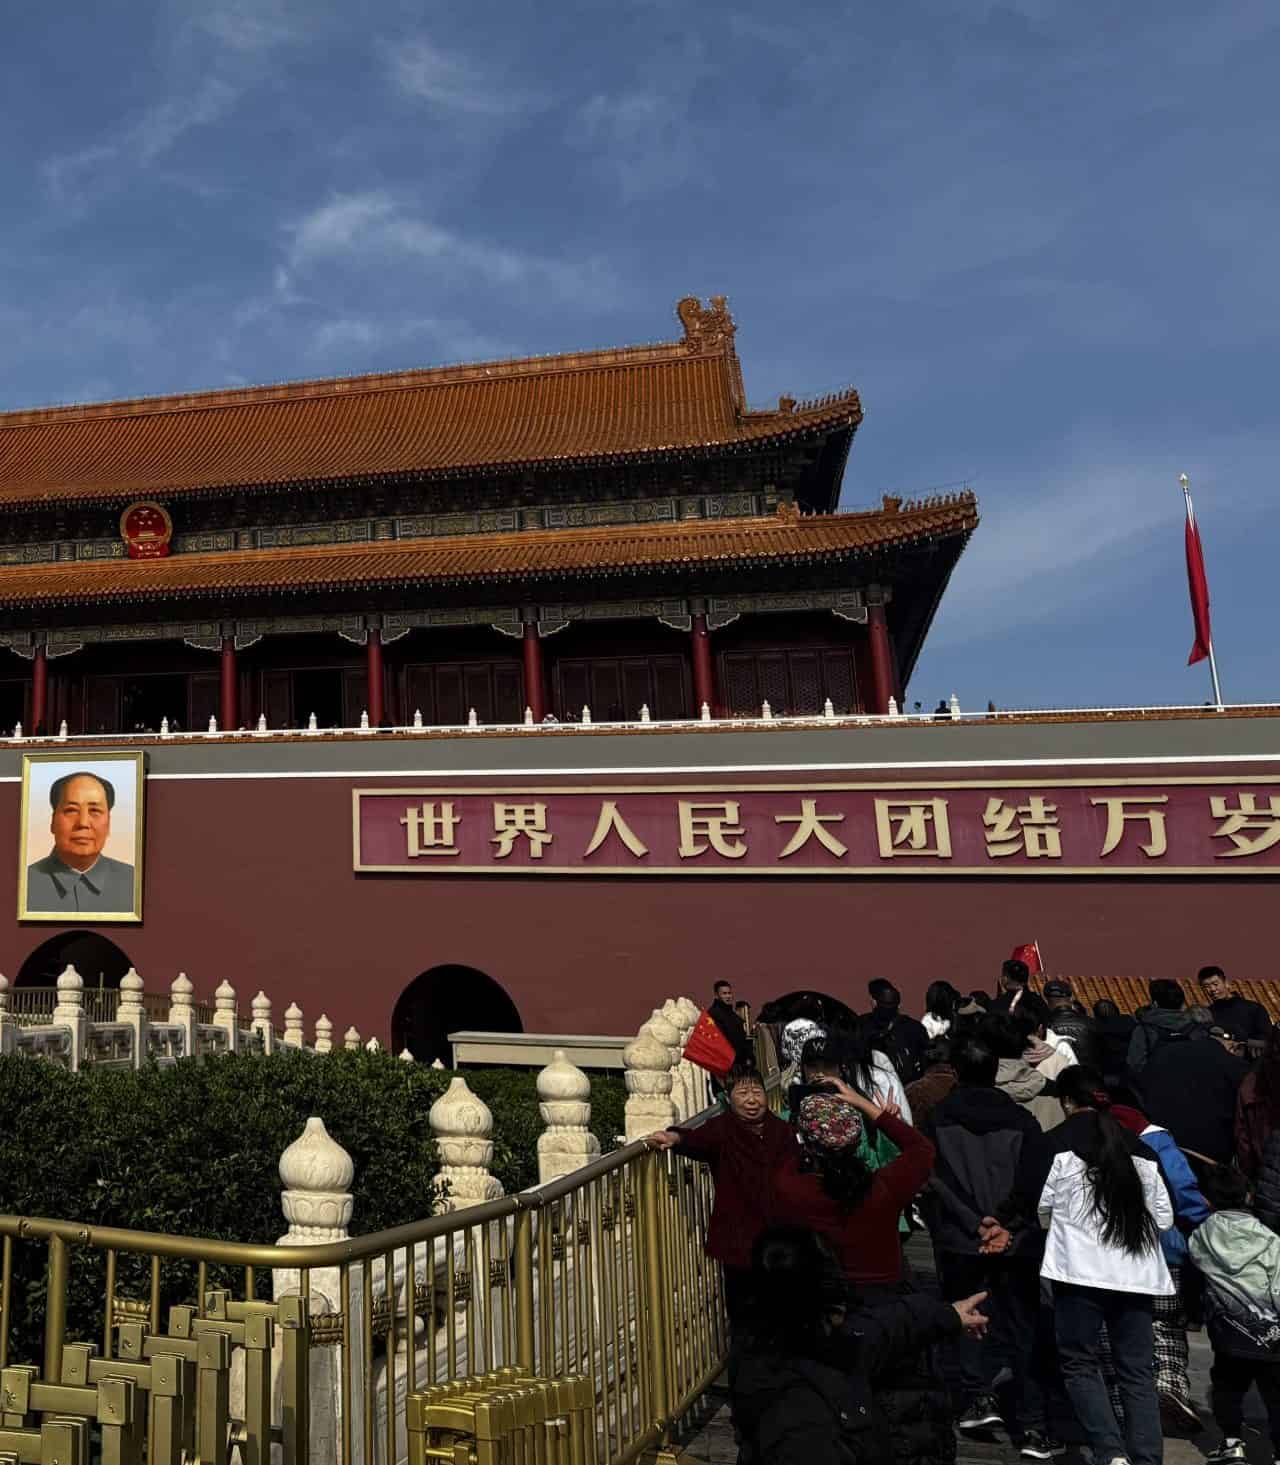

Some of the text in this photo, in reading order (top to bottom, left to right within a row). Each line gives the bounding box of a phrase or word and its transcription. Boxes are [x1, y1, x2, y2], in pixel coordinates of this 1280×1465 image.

[400, 792, 1280, 860] 世界人民大团结万岁
